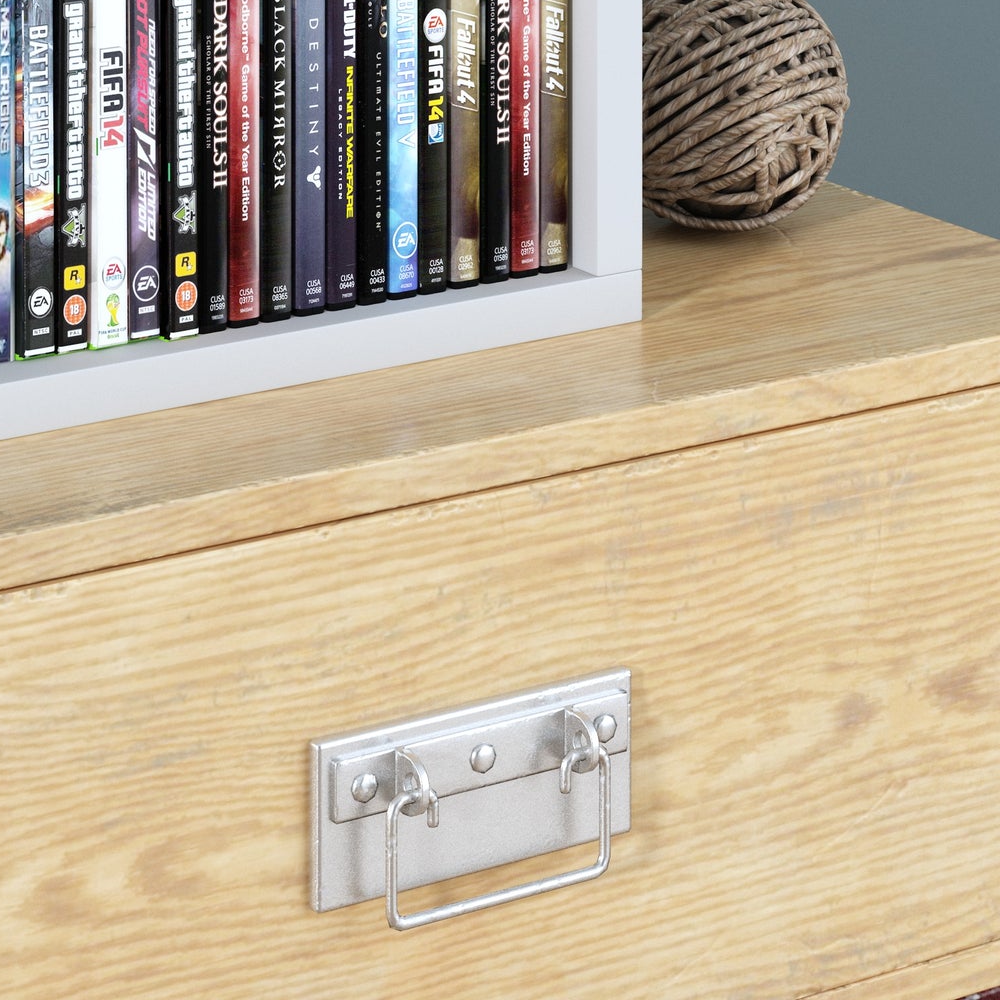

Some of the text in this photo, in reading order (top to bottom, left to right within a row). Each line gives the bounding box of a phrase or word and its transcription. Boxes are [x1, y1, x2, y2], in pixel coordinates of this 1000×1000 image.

[427, 26, 444, 35] SPORTS
[428, 16, 443, 28] EA
[343, 9, 356, 58] DUTY
[522, 25, 531, 61] Game
[545, 5, 564, 92] Fallout 4
[456, 17, 476, 105] Fallout 4
[522, 65, 531, 77] of
[136, 30, 149, 132] PURSUIT
[241, 64, 250, 101] Game
[309, 18, 319, 156] DESTINY
[428, 44, 444, 122] FIFA 14
[497, 42, 510, 122] SOULS
[523, 79, 531, 99] the
[63, 3, 87, 200] grand theft auto
[103, 50, 124, 147] FIFA 14
[178, 61, 197, 129] theft
[213, 0, 228, 189] DARK SOULS II
[0, 62, 11, 154] ORIGINS
[29, 24, 50, 188] BATTLEFIELD 3
[241, 106, 250, 118] of
[523, 102, 531, 130] Year
[241, 121, 250, 142] the
[398, 129, 416, 150] V
[497, 126, 510, 145] II
[346, 66, 354, 219] INFINITE WARFARE
[178, 130, 194, 187] auto
[241, 144, 250, 173] Year
[523, 133, 531, 176] Edition
[138, 166, 147, 232] EDITION
[147, 171, 157, 241] LIMITED
[241, 176, 250, 222] Edition
[398, 232, 416, 247] EA
[521, 240, 535, 248] CUSA
[547, 240, 561, 248] CUSA
[459, 255, 473, 263] CUSA
[494, 246, 508, 254] CUSA
[106, 264, 122, 276] EA
[399, 264, 413, 273] CUSA
[429, 258, 443, 267] CUSA
[105, 273, 123, 281] SPORTS
[137, 275, 157, 291] EA
[307, 279, 321, 287] CUSA
[340, 274, 354, 282] CUSA
[370, 269, 385, 277] CUSA
[181, 291, 191, 301] 18
[210, 295, 225, 303] CUSA
[239, 288, 254, 296] CUSA
[272, 285, 287, 293] CUSA
[34, 295, 49, 307] EA
[70, 305, 79, 316] 18
